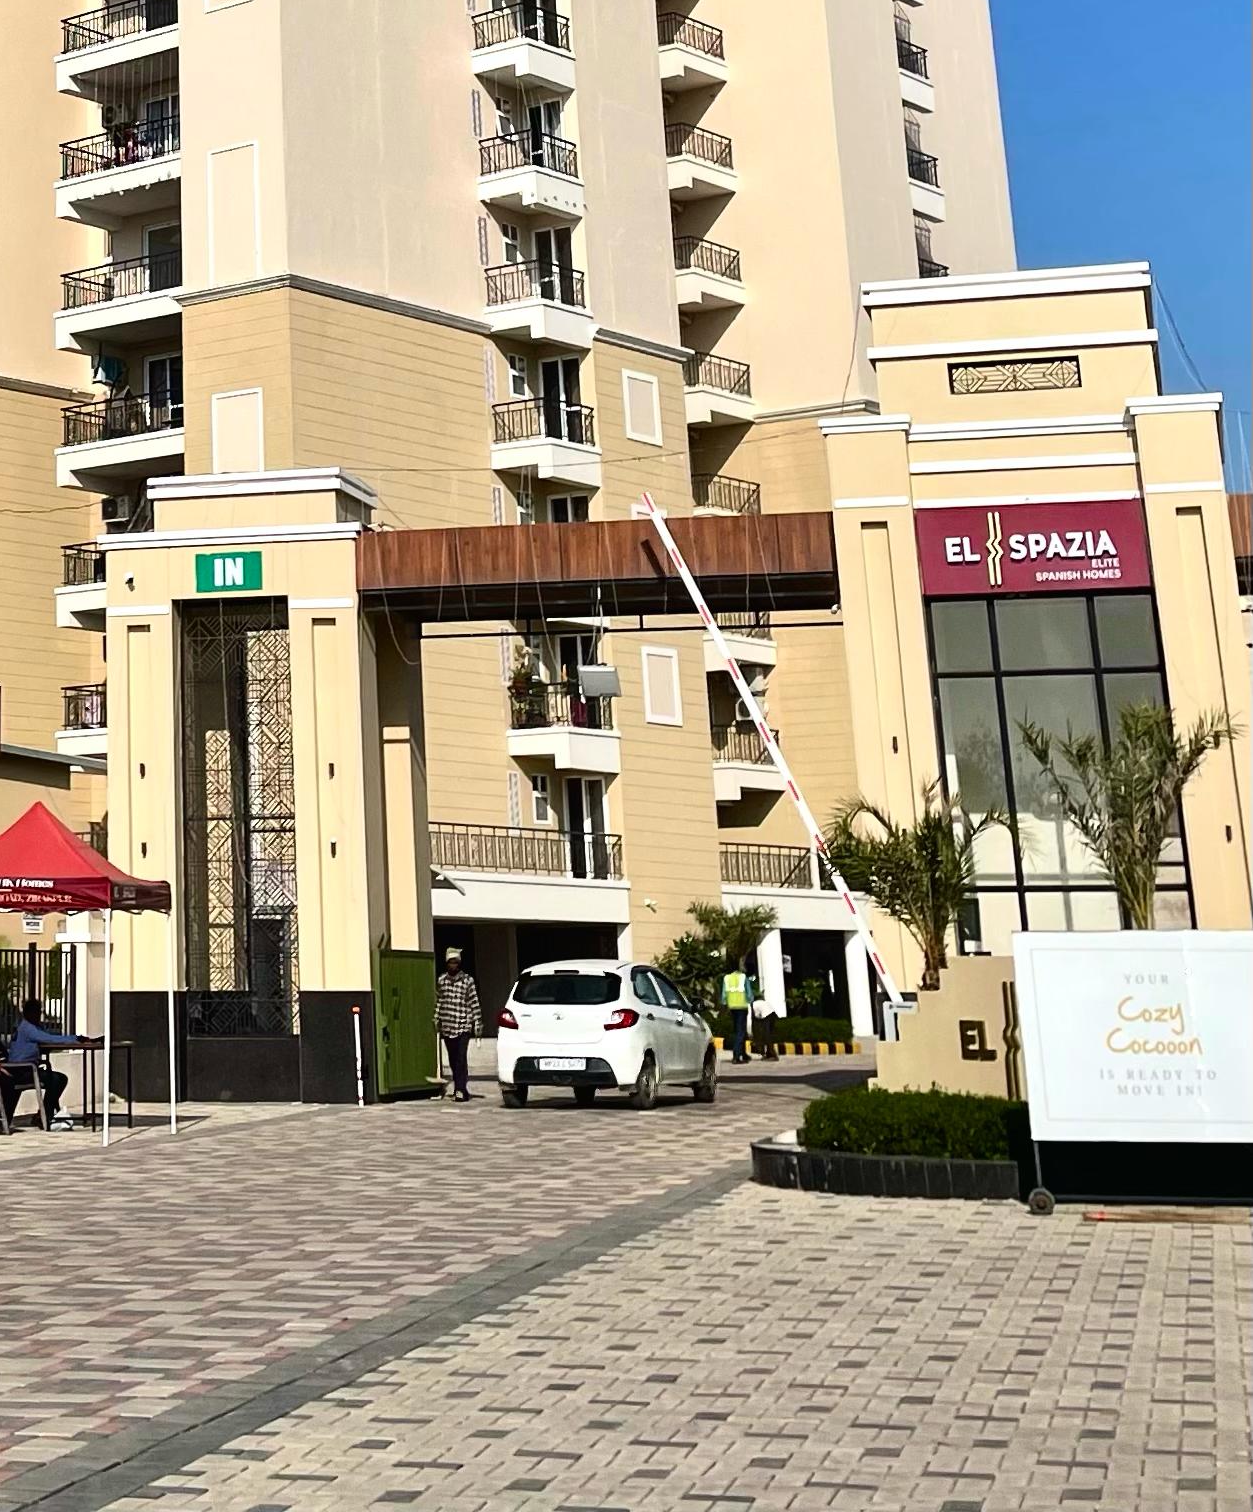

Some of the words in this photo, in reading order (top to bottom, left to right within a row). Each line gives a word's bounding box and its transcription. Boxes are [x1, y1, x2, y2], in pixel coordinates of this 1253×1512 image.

[944, 536, 981, 563] EL
[1008, 529, 1117, 560] SPAZIA
[1091, 557, 1120, 568] ELITE
[213, 557, 244, 586] IN
[1035, 570, 1081, 582] SPANISH
[1082, 568, 1122, 580] HOMES
[1123, 973, 1169, 985] YOUR
[1117, 995, 1185, 1036] Cozy
[1100, 1068, 1115, 1081] IS
[1126, 1068, 1183, 1081] READY
[1195, 1069, 1217, 1081] TO
[1117, 1084, 1165, 1096] MOVE
